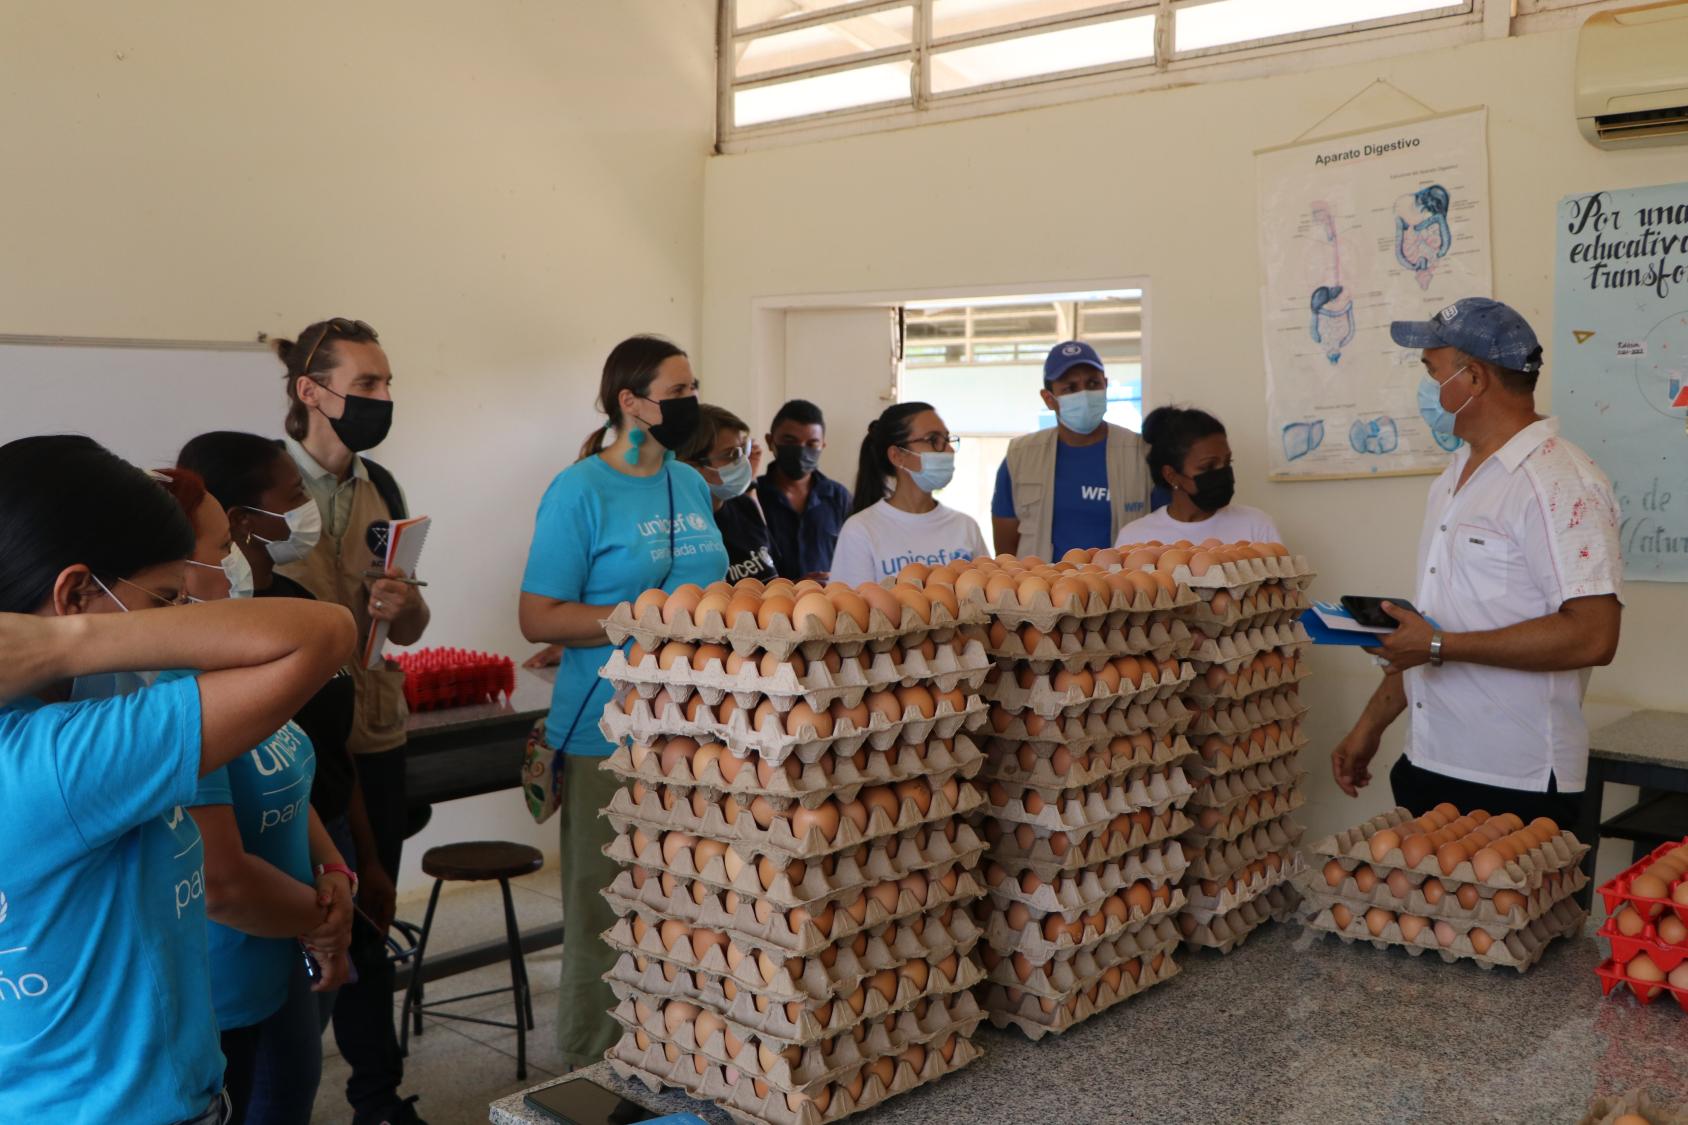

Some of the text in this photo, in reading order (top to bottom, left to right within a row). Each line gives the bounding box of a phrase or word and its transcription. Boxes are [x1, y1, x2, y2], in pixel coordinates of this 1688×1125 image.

[1315, 137, 1420, 166] Aparato Digestivo
[1567, 191, 1621, 235] Por
[1586, 257, 1688, 299] transfo
[1642, 477, 1671, 512] de
